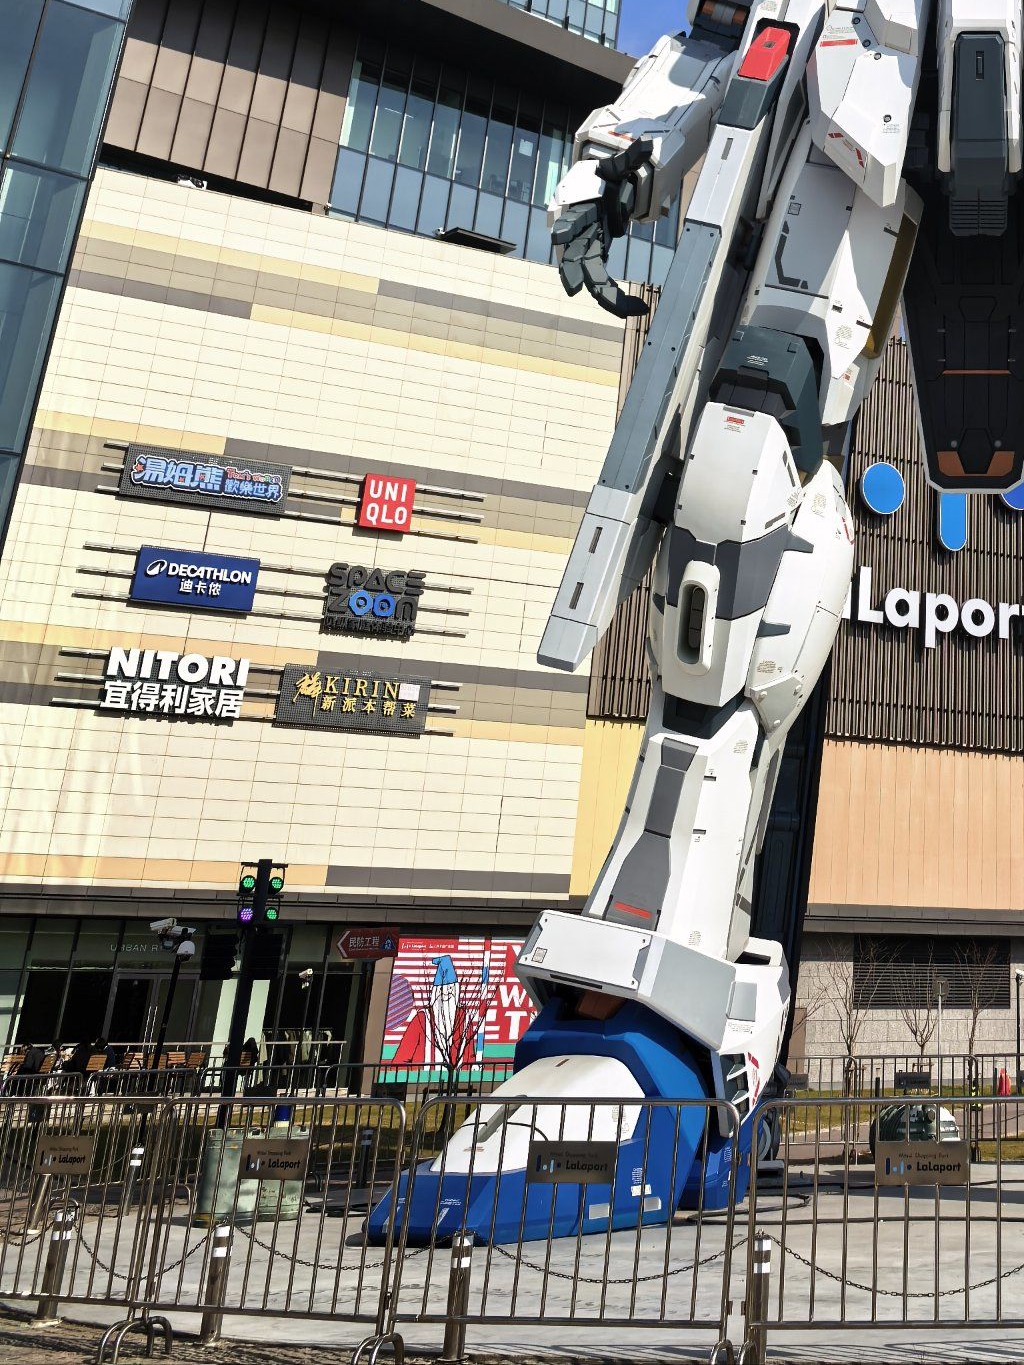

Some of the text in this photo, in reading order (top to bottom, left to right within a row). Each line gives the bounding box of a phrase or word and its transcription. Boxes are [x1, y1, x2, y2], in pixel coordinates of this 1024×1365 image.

[370, 479, 408, 502] UNI
[366, 502, 408, 526] QLO
[167, 562, 252, 584] DECATHLON
[325, 562, 426, 596] SPACE
[179, 578, 222, 596] 迪卡侬
[106, 646, 250, 687] NITORI
[323, 675, 400, 700] KIRIN
[100, 680, 246, 719] 宜得利家居
[320, 695, 417, 718] 新派本帮菜
[267, 1158, 301, 1171] LaLaport
[565, 1160, 608, 1173] LaLaport
[916, 1161, 962, 1174] LaLaport
